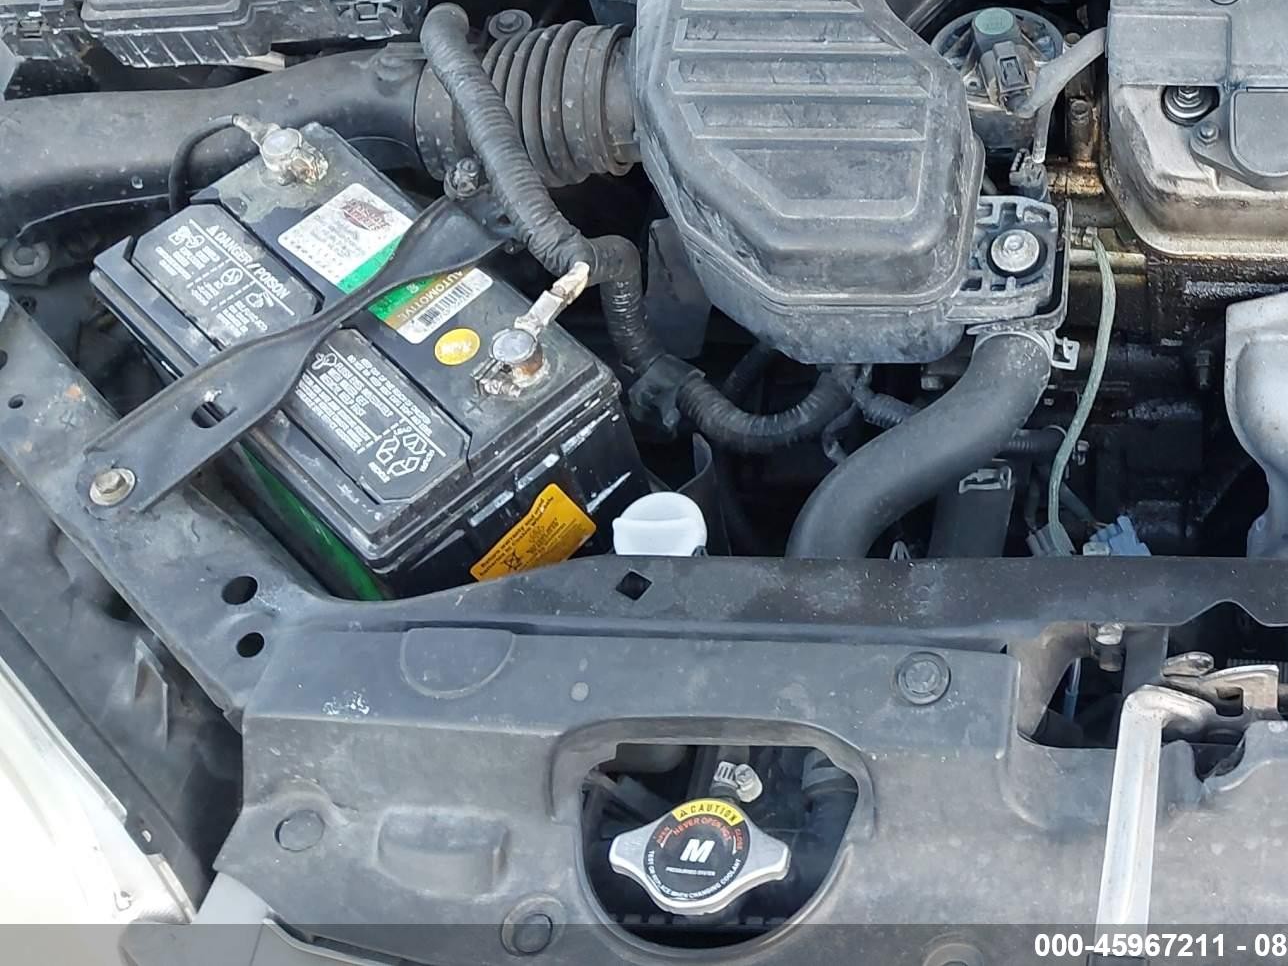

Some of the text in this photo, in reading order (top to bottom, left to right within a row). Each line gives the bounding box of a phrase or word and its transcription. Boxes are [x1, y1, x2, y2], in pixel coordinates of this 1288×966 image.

[396, 270, 463, 321] AUTOMOTIVE
[690, 803, 737, 821] CAUTION
[672, 817, 700, 835] NEVER
[679, 838, 715, 863] M
[720, 858, 741, 884] COOLANT
